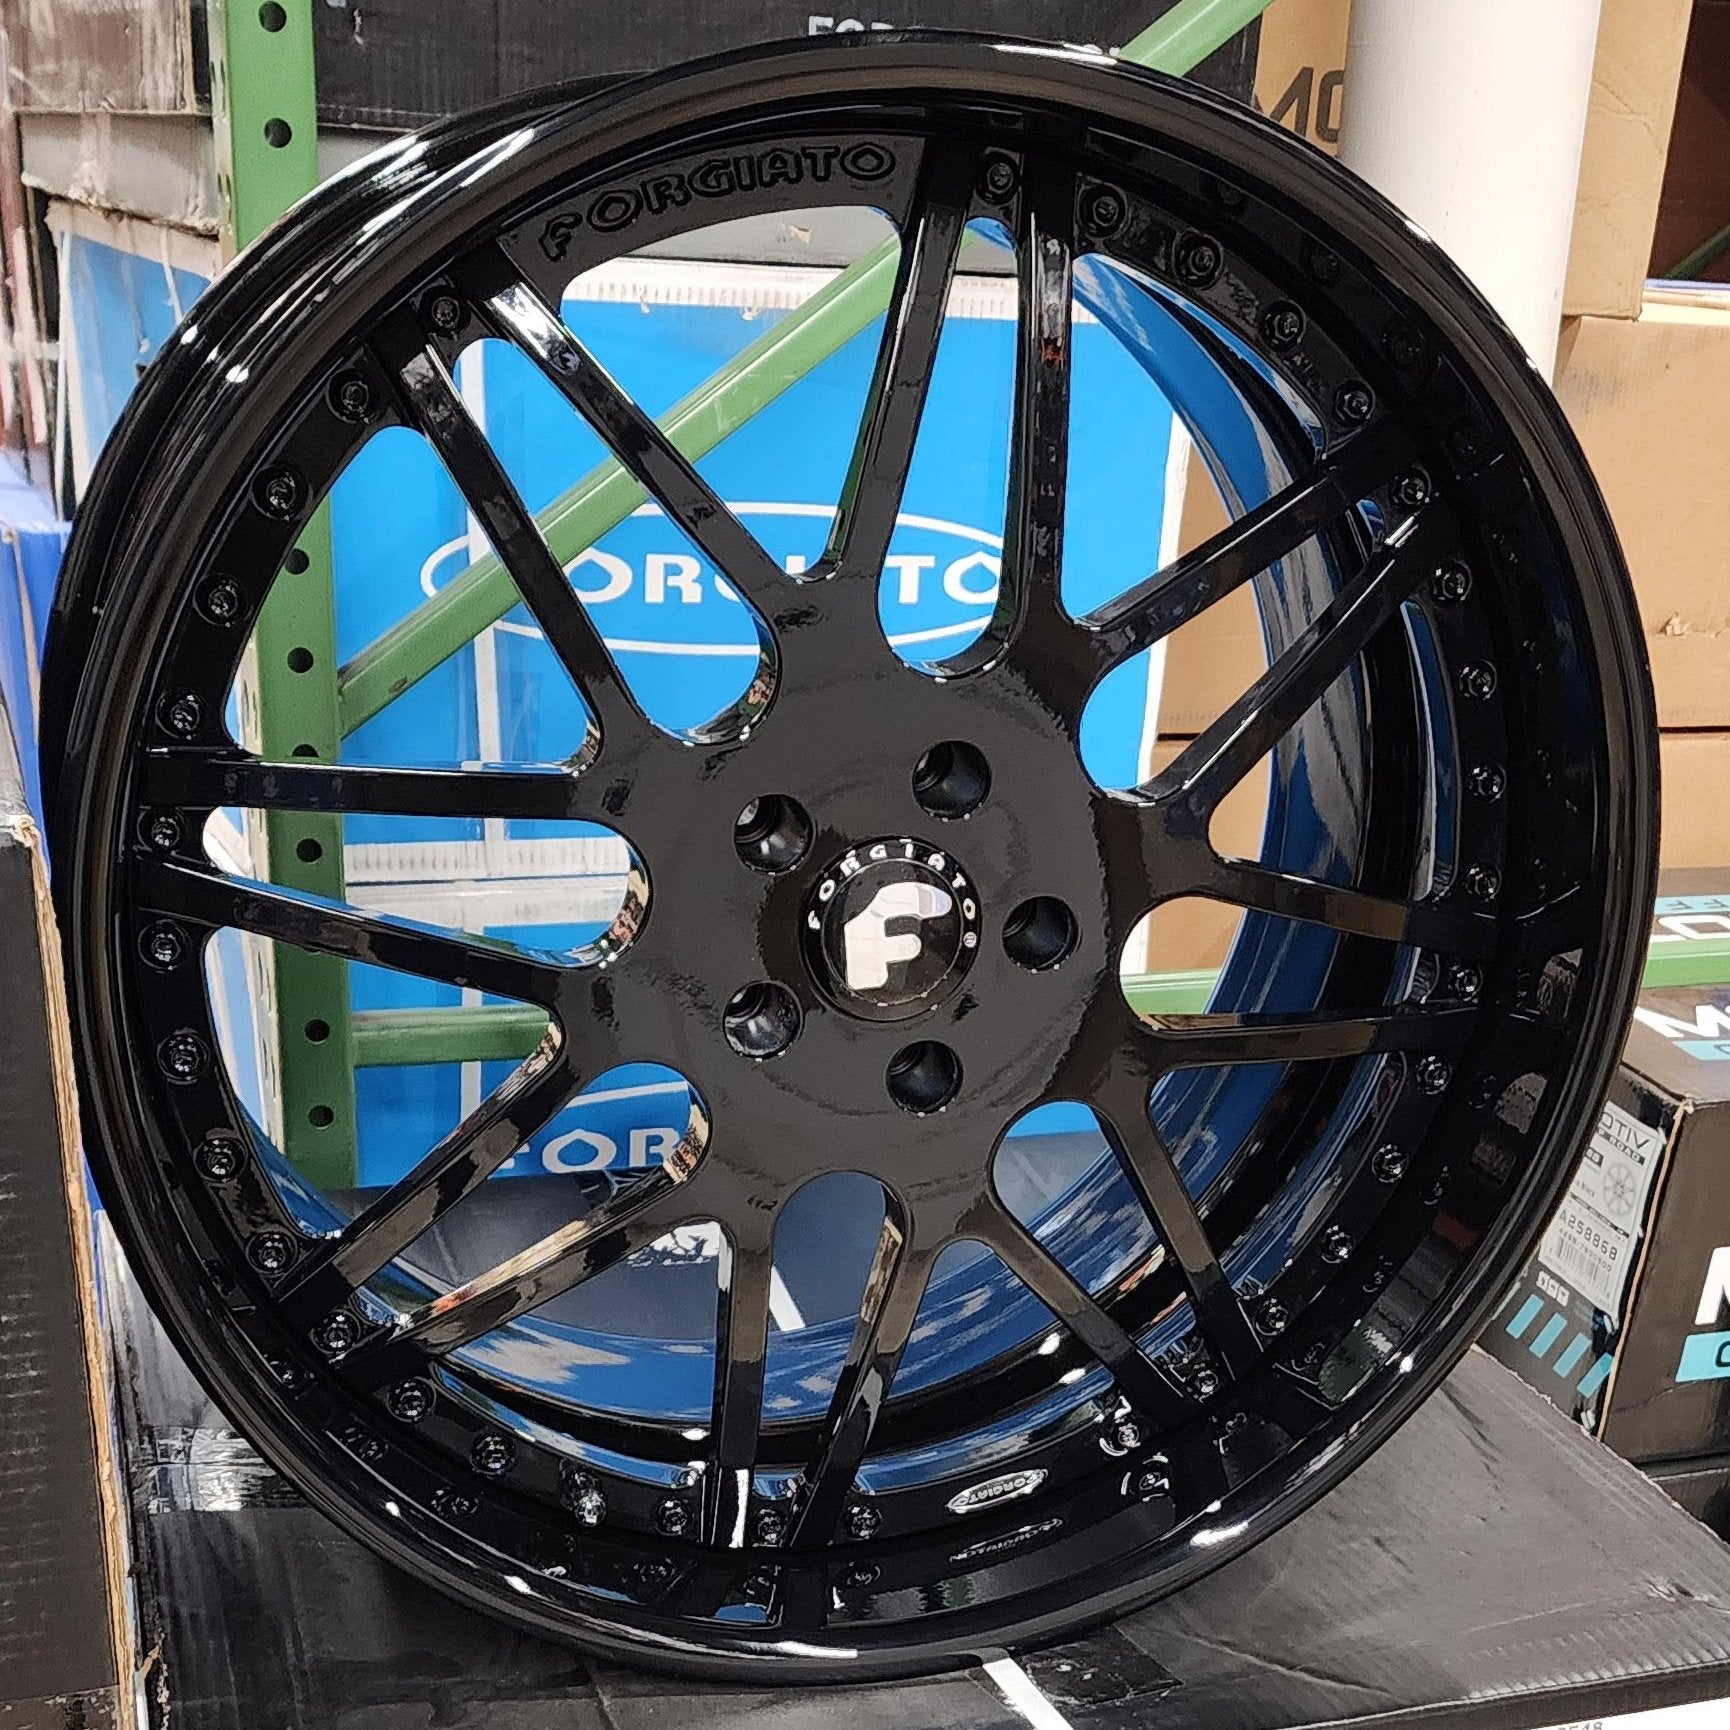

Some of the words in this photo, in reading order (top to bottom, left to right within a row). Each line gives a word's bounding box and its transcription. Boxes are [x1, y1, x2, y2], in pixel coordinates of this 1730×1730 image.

[538, 142, 897, 262] FORGIATO
[807, 838, 977, 931] FORGIATO
[843, 881, 953, 991] F
